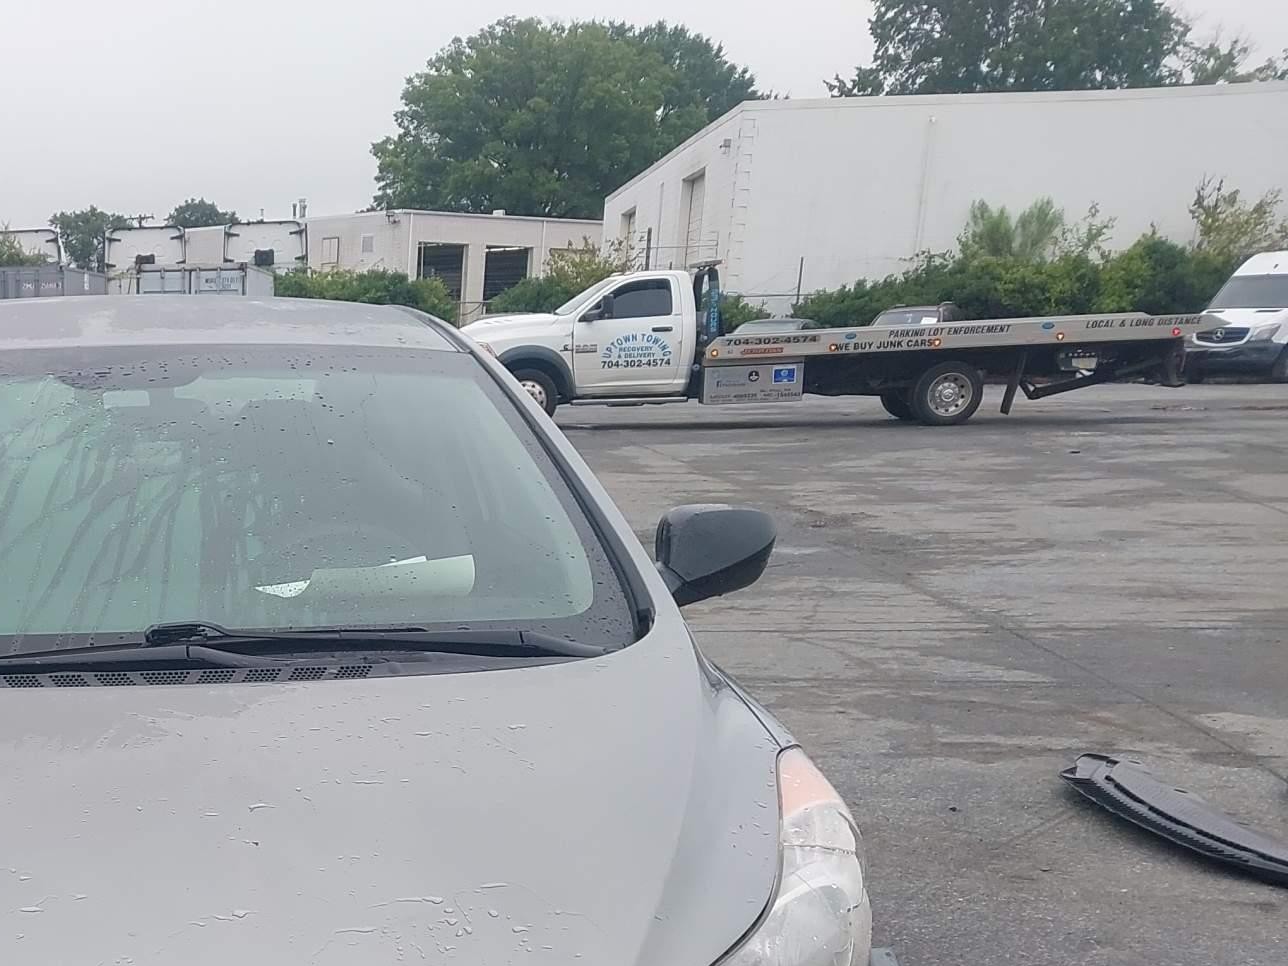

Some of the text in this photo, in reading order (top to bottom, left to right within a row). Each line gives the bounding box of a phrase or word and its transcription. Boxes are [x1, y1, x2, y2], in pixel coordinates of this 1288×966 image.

[1085, 315, 1203, 329] LOCAL & LONG DISTANCE
[888, 324, 1012, 339] PARKING LOT ENFORCEMENT
[601, 333, 672, 359] UPTOWN TOWING
[726, 335, 817, 346] 704-302-4574
[835, 338, 934, 351] WE BUY JUNK CARS
[618, 345, 653, 353] RECOVERY
[601, 358, 671, 369] 704-302-4574
